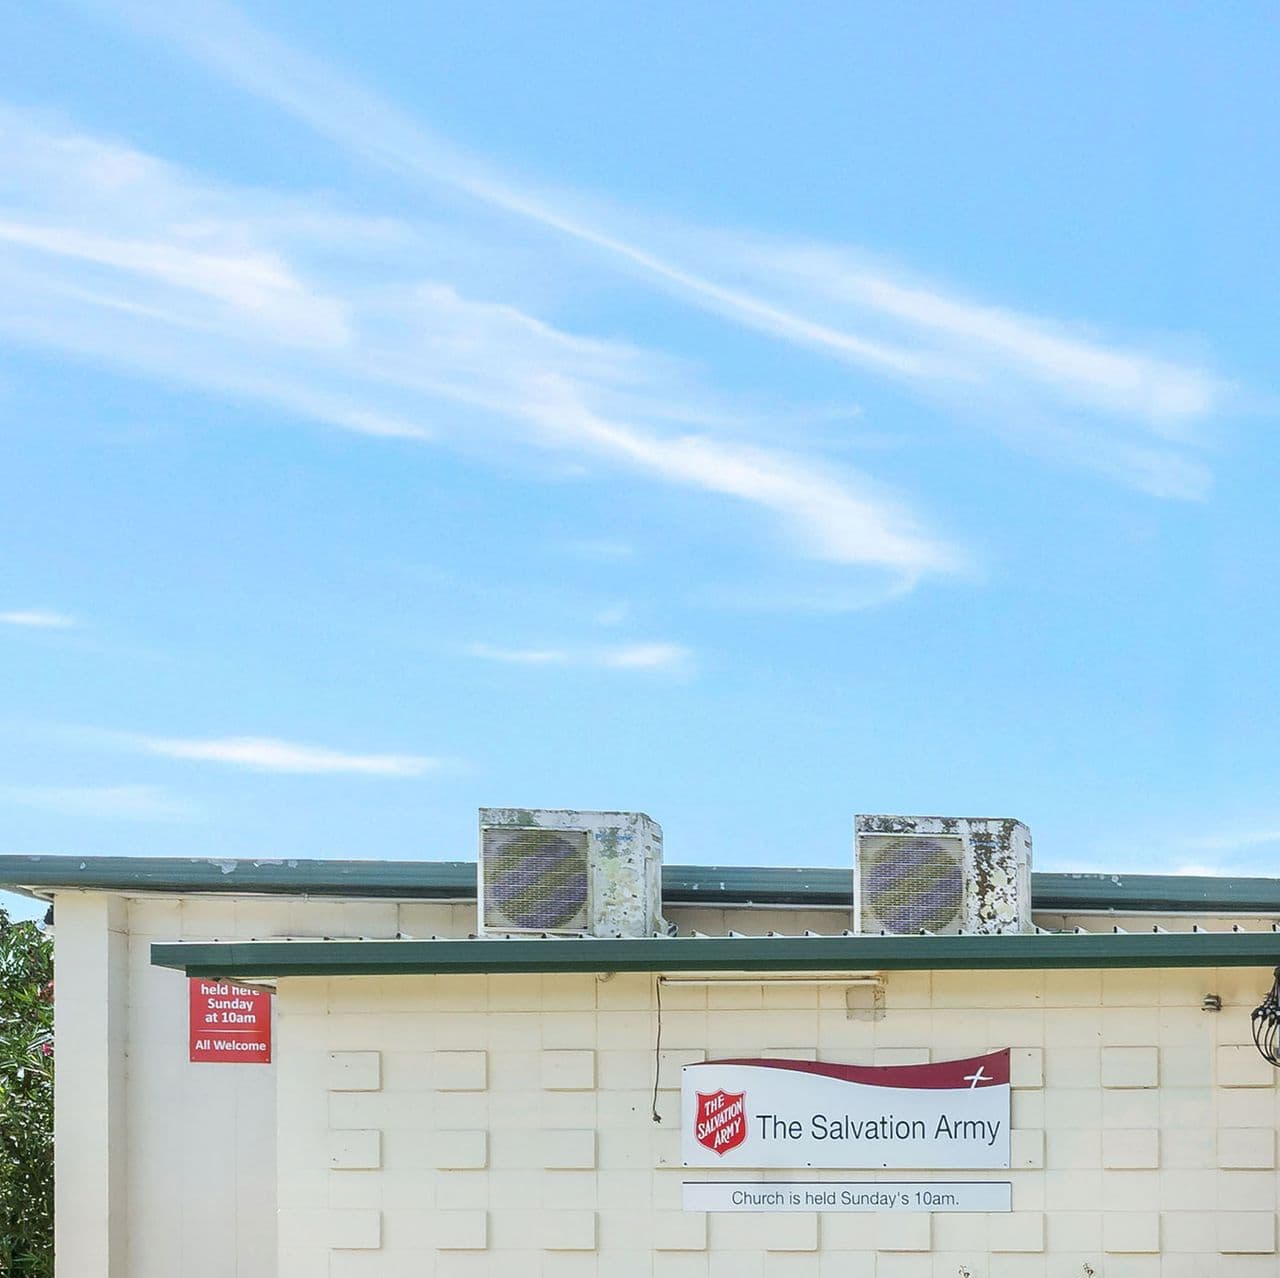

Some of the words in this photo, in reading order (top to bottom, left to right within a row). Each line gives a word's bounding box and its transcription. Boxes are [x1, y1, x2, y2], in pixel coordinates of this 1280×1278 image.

[201, 984, 228, 995] held
[208, 998, 253, 1011] Sunday
[205, 1013, 218, 1023] at
[221, 1012, 256, 1023] 10am
[195, 1040, 210, 1050] All
[214, 1040, 266, 1051] Welcome
[704, 1094, 725, 1117] THE
[697, 1097, 743, 1140] SALVATION
[713, 1117, 741, 1149] ARMY
[756, 1115, 803, 1140] The
[811, 1115, 926, 1140] Salvation
[934, 1115, 1001, 1146] Army
[731, 1191, 785, 1205] Church
[789, 1191, 801, 1205] is
[805, 1191, 837, 1205] held
[841, 1190, 910, 1208] Sunday's
[915, 1191, 960, 1205] 10am.
